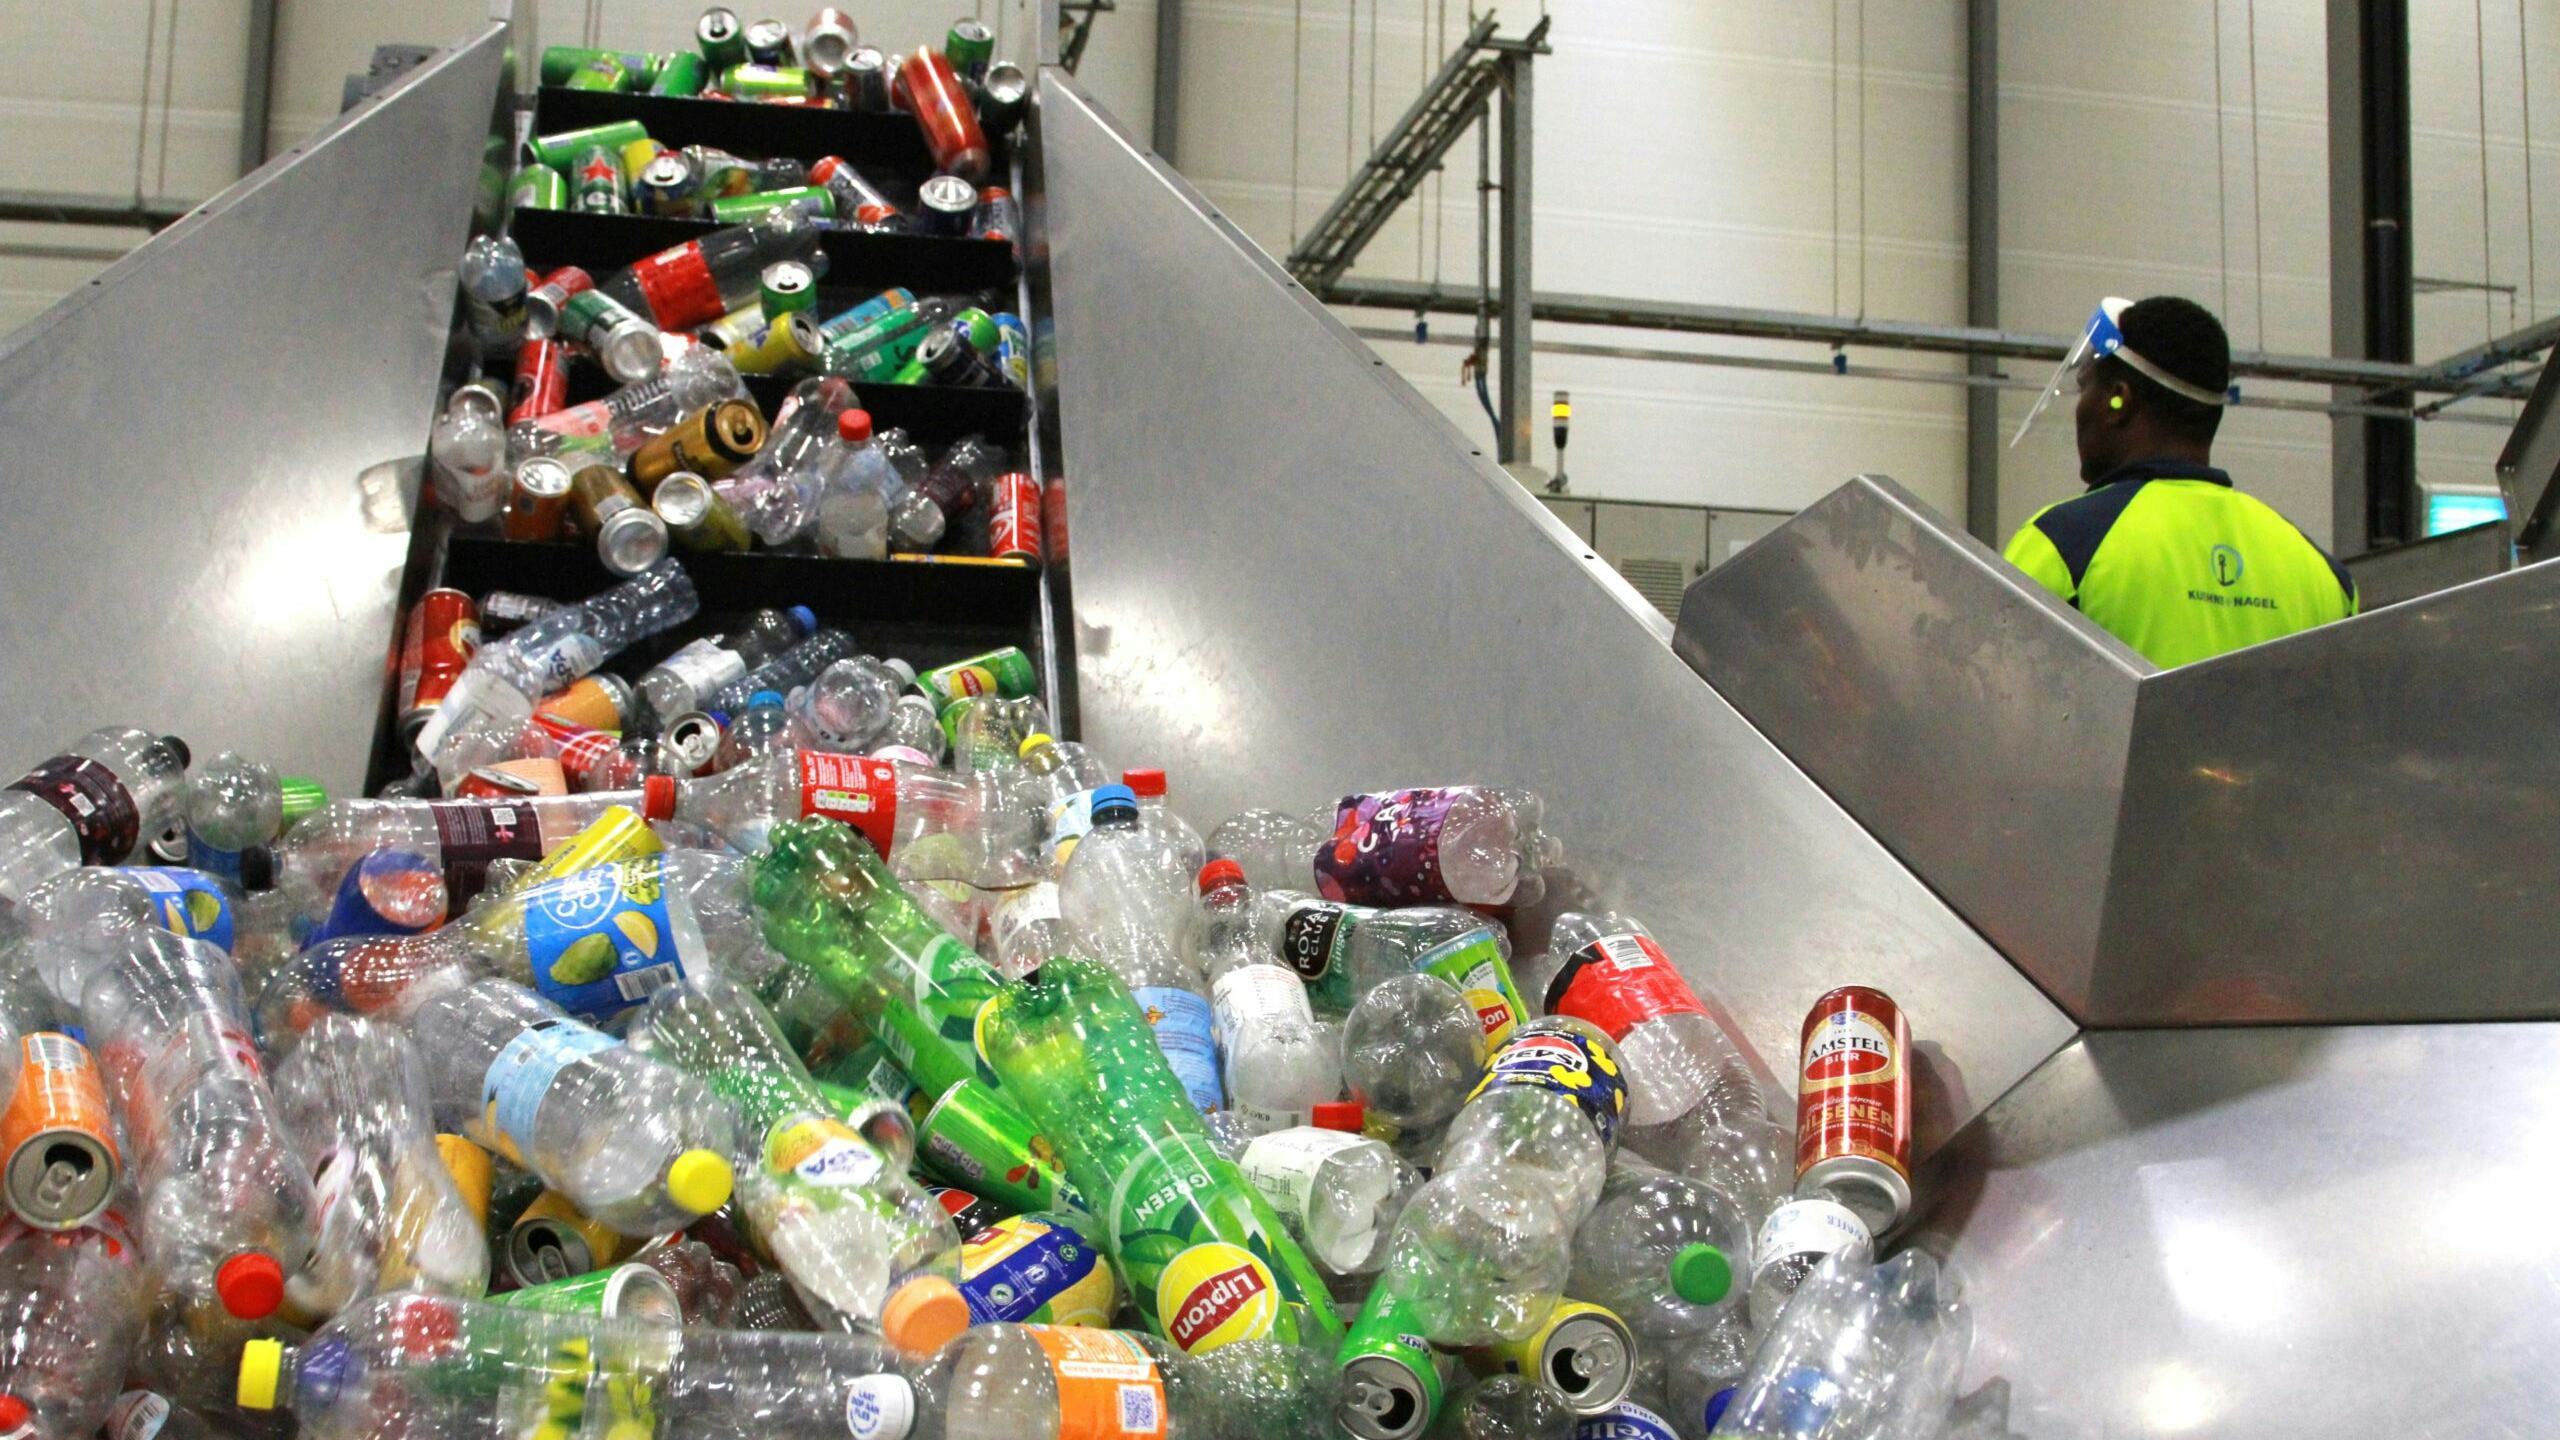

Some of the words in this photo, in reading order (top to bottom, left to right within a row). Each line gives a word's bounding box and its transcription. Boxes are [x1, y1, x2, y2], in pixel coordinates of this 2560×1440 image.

[2233, 597, 2278, 609] NAGEL
[1311, 916, 1329, 956] CLUB
[1498, 1049, 1583, 1070] PEPSI
[1809, 1037, 1882, 1064] AMSTEL
[1824, 1052, 1860, 1065] BIER
[1177, 1272, 1256, 1340] Lipton
